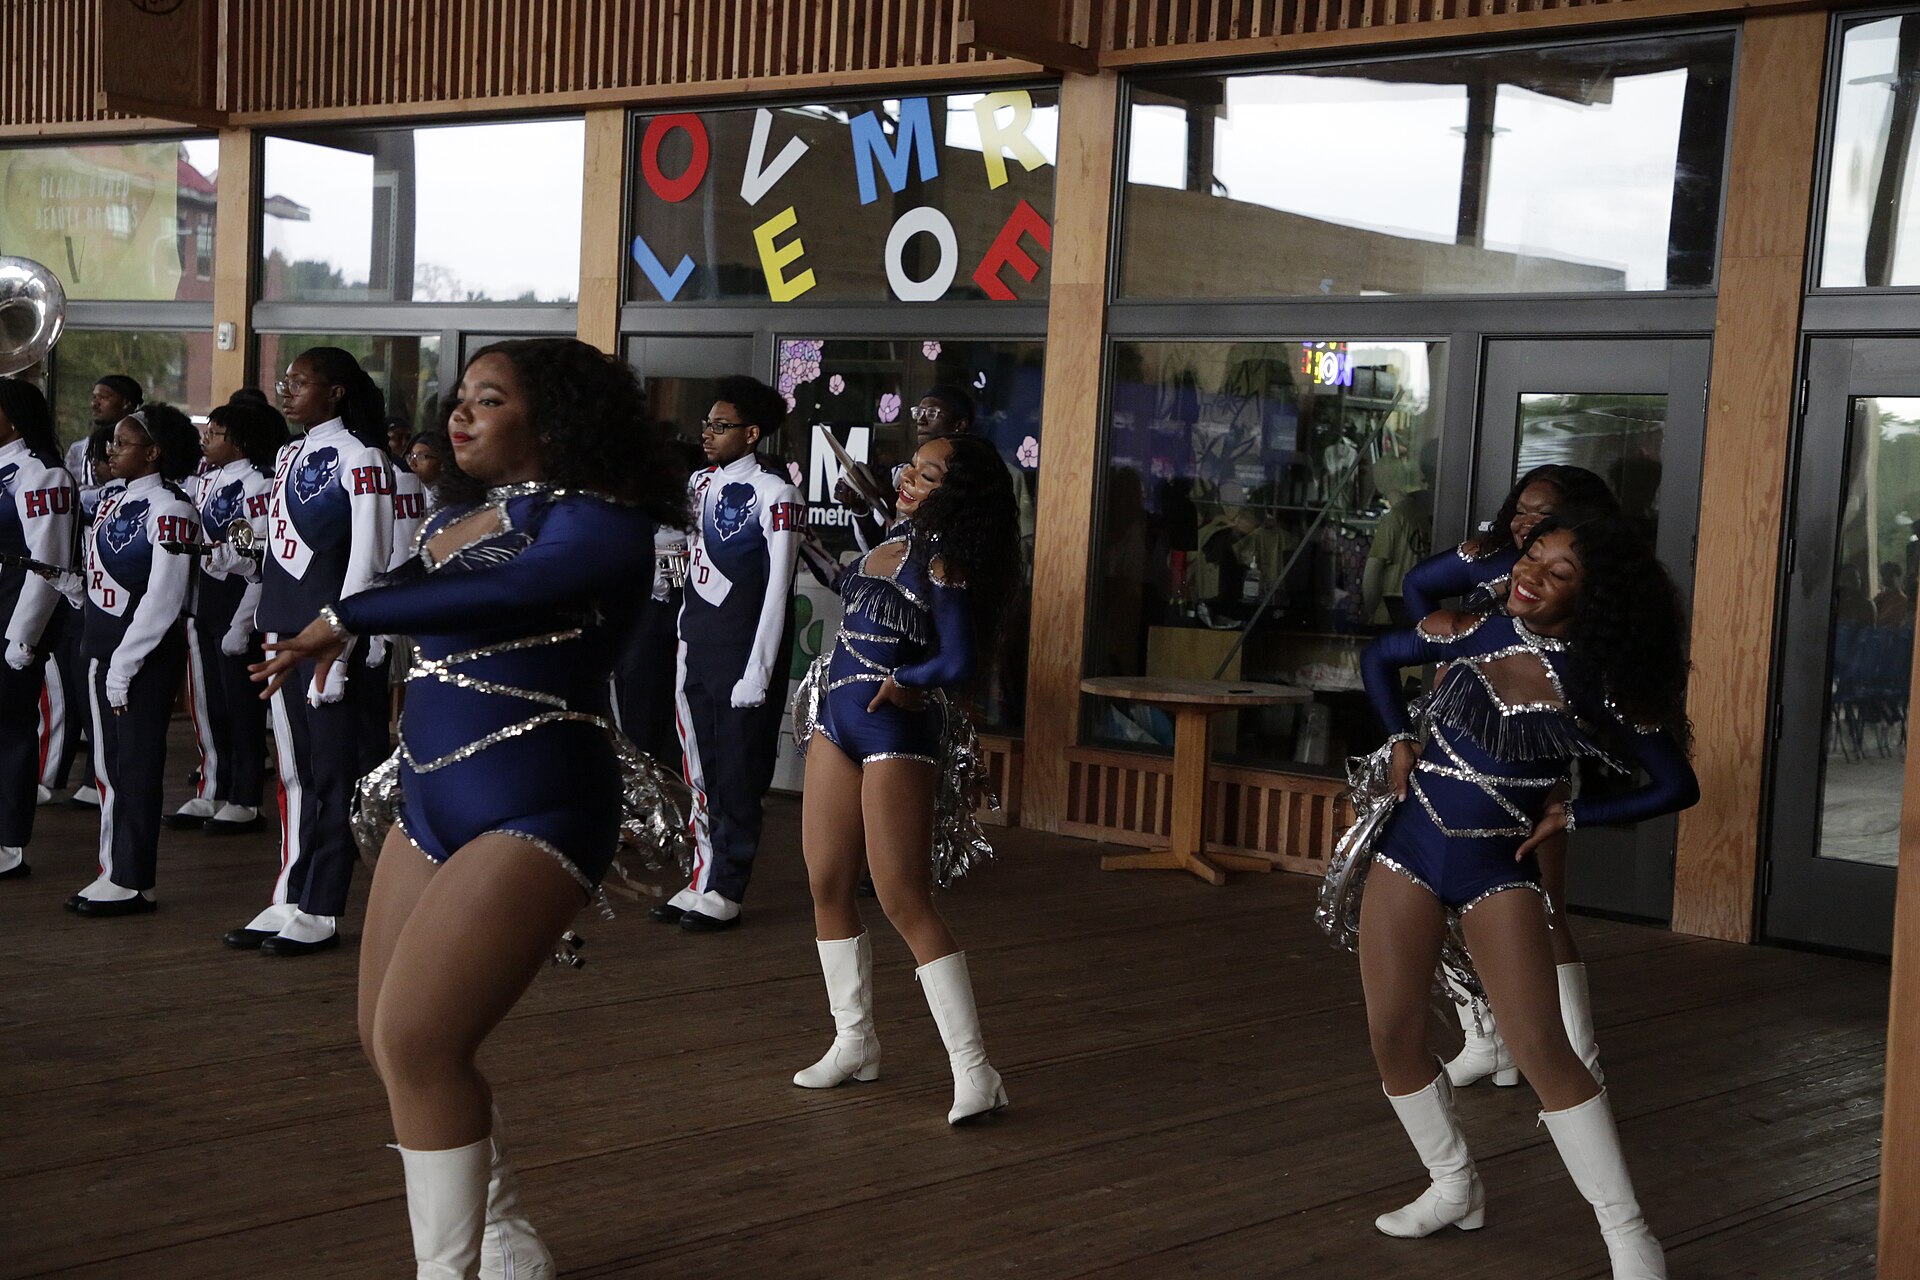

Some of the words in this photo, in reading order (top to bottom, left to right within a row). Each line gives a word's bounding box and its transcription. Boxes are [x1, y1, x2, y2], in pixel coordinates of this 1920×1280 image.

[41, 175, 81, 200] BLACK
[89, 174, 130, 198] OWNED
[35, 206, 80, 231] BEAUTY
[808, 505, 853, 527] metr
